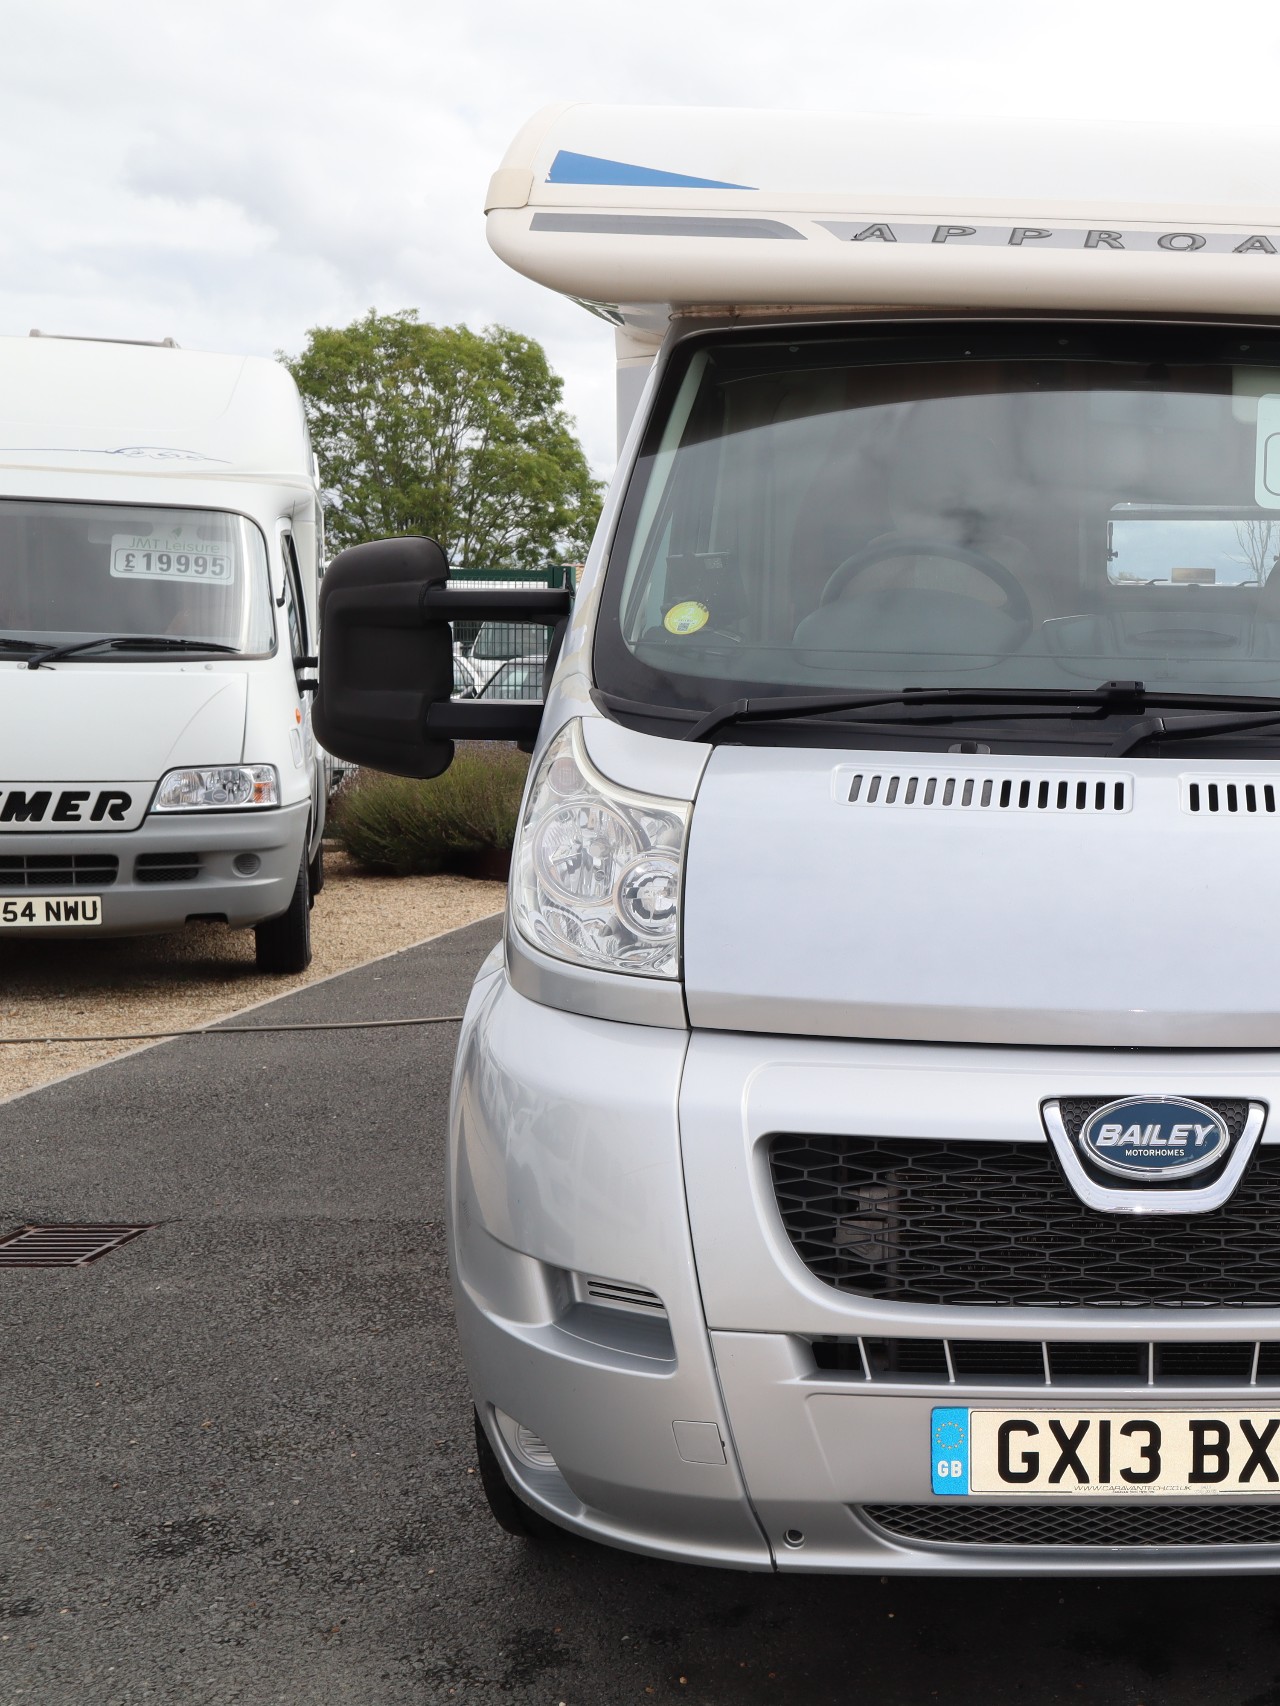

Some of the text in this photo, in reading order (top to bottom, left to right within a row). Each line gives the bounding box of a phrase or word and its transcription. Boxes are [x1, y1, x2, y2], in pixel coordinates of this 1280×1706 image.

[128, 537, 220, 553] JMT Leisure
[123, 552, 225, 576] £19995
[0, 790, 132, 822] MER
[2, 900, 98, 922] 54 NWU
[1096, 1124, 1215, 1147] BAILEY
[1125, 1149, 1185, 1157] MOTORHOMES
[997, 1420, 1162, 1484] GX13
[937, 1460, 962, 1478] GB
